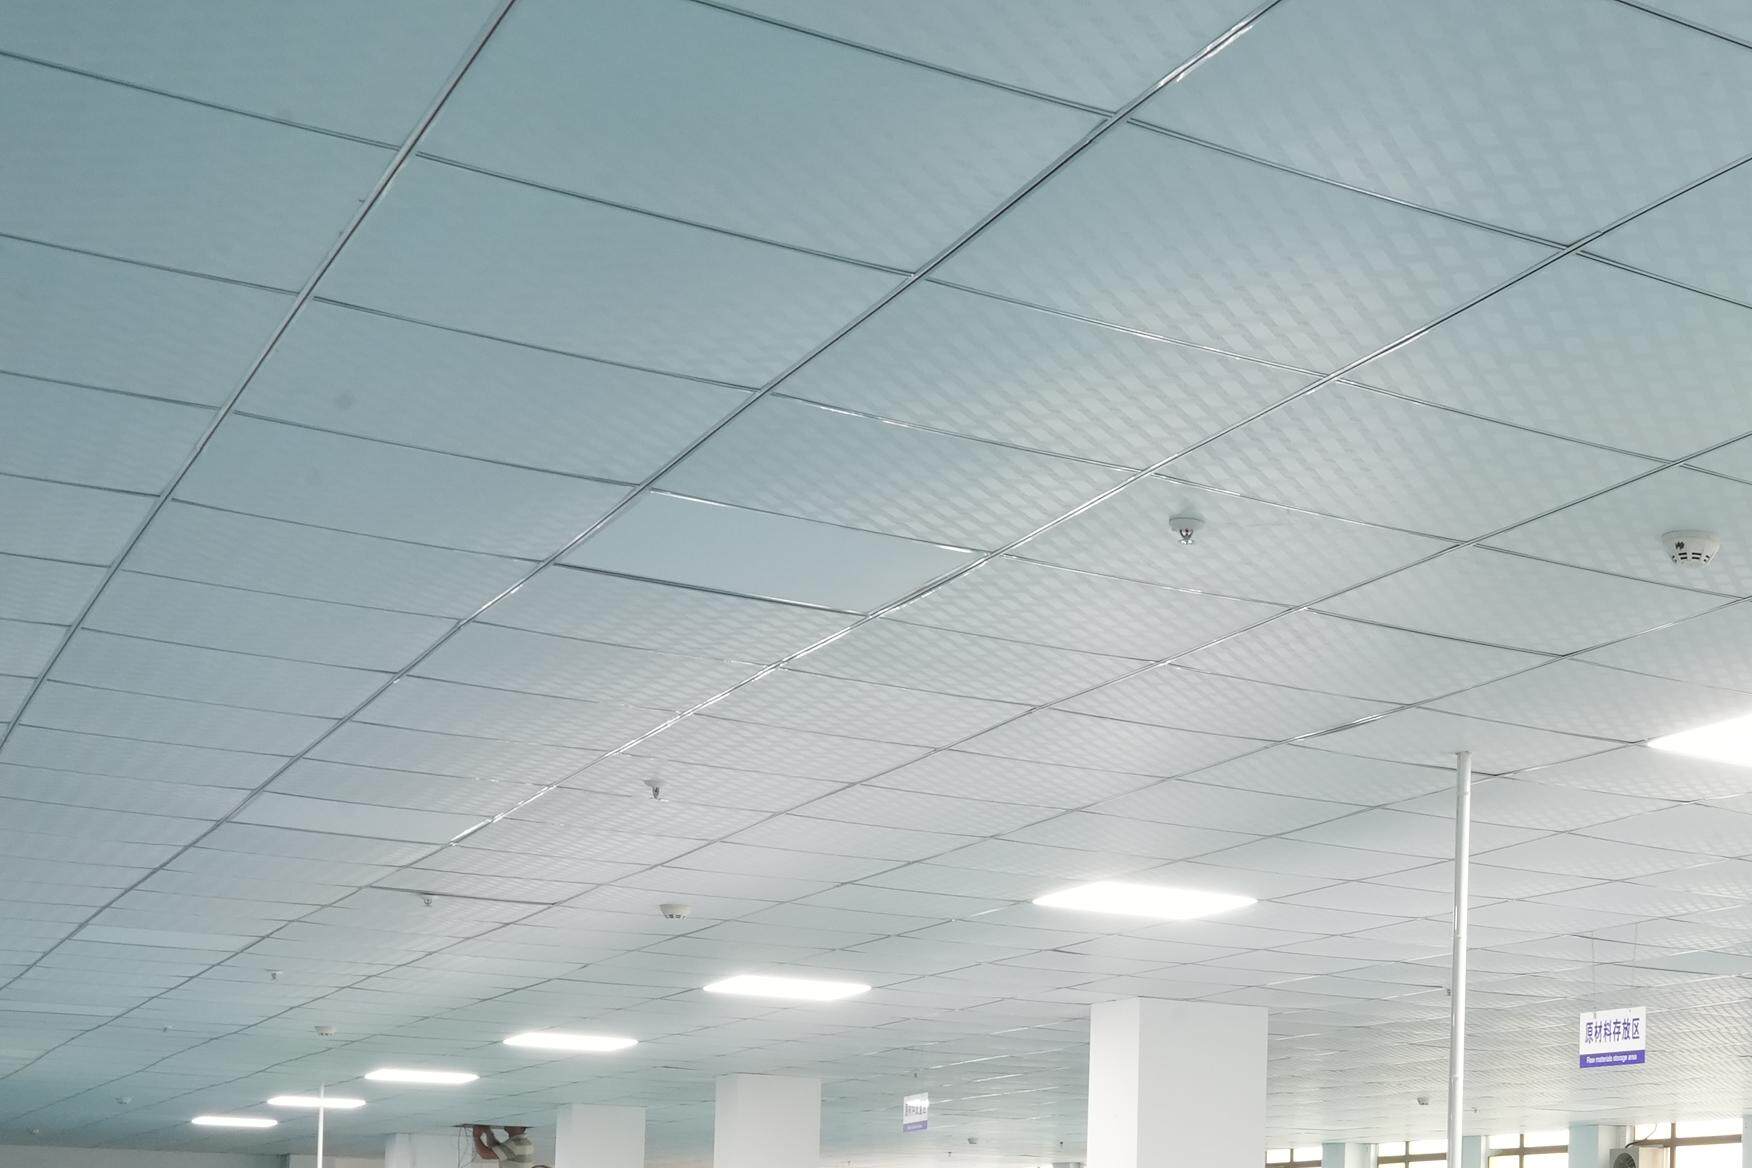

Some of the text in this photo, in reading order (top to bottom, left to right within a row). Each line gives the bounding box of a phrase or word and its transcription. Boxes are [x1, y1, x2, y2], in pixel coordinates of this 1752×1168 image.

[1585, 1017, 1640, 1044] 原材料存放区
